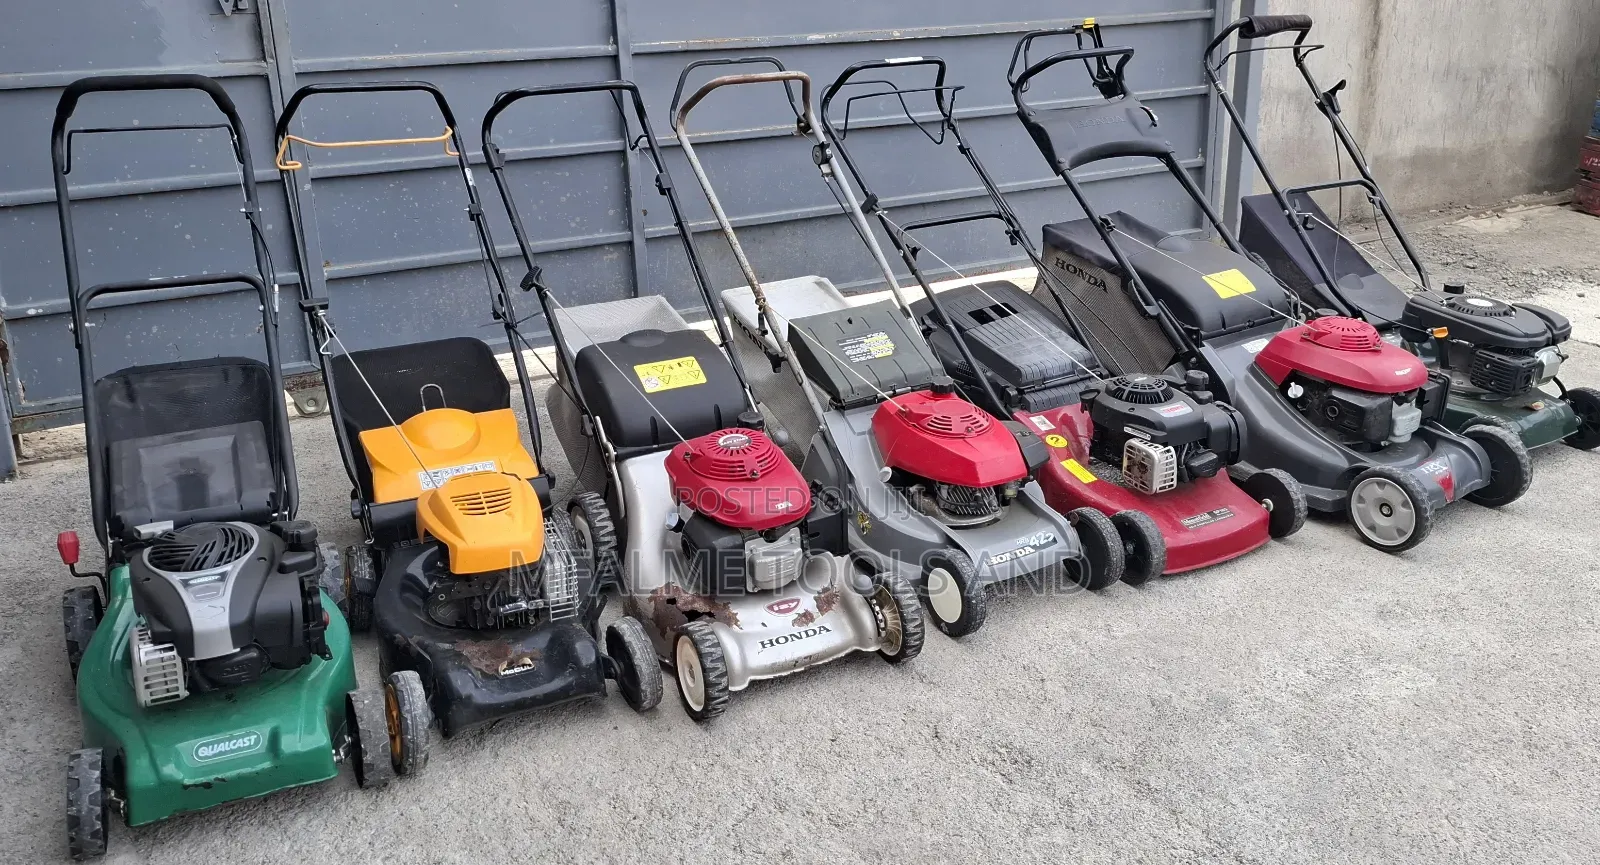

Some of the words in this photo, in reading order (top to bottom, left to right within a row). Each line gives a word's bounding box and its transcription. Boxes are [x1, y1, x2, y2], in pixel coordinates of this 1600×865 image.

[1054, 256, 1108, 294] HONDA
[985, 546, 1036, 565] HONDA
[758, 625, 833, 650] HONDA
[197, 734, 258, 757] QUALCAST
